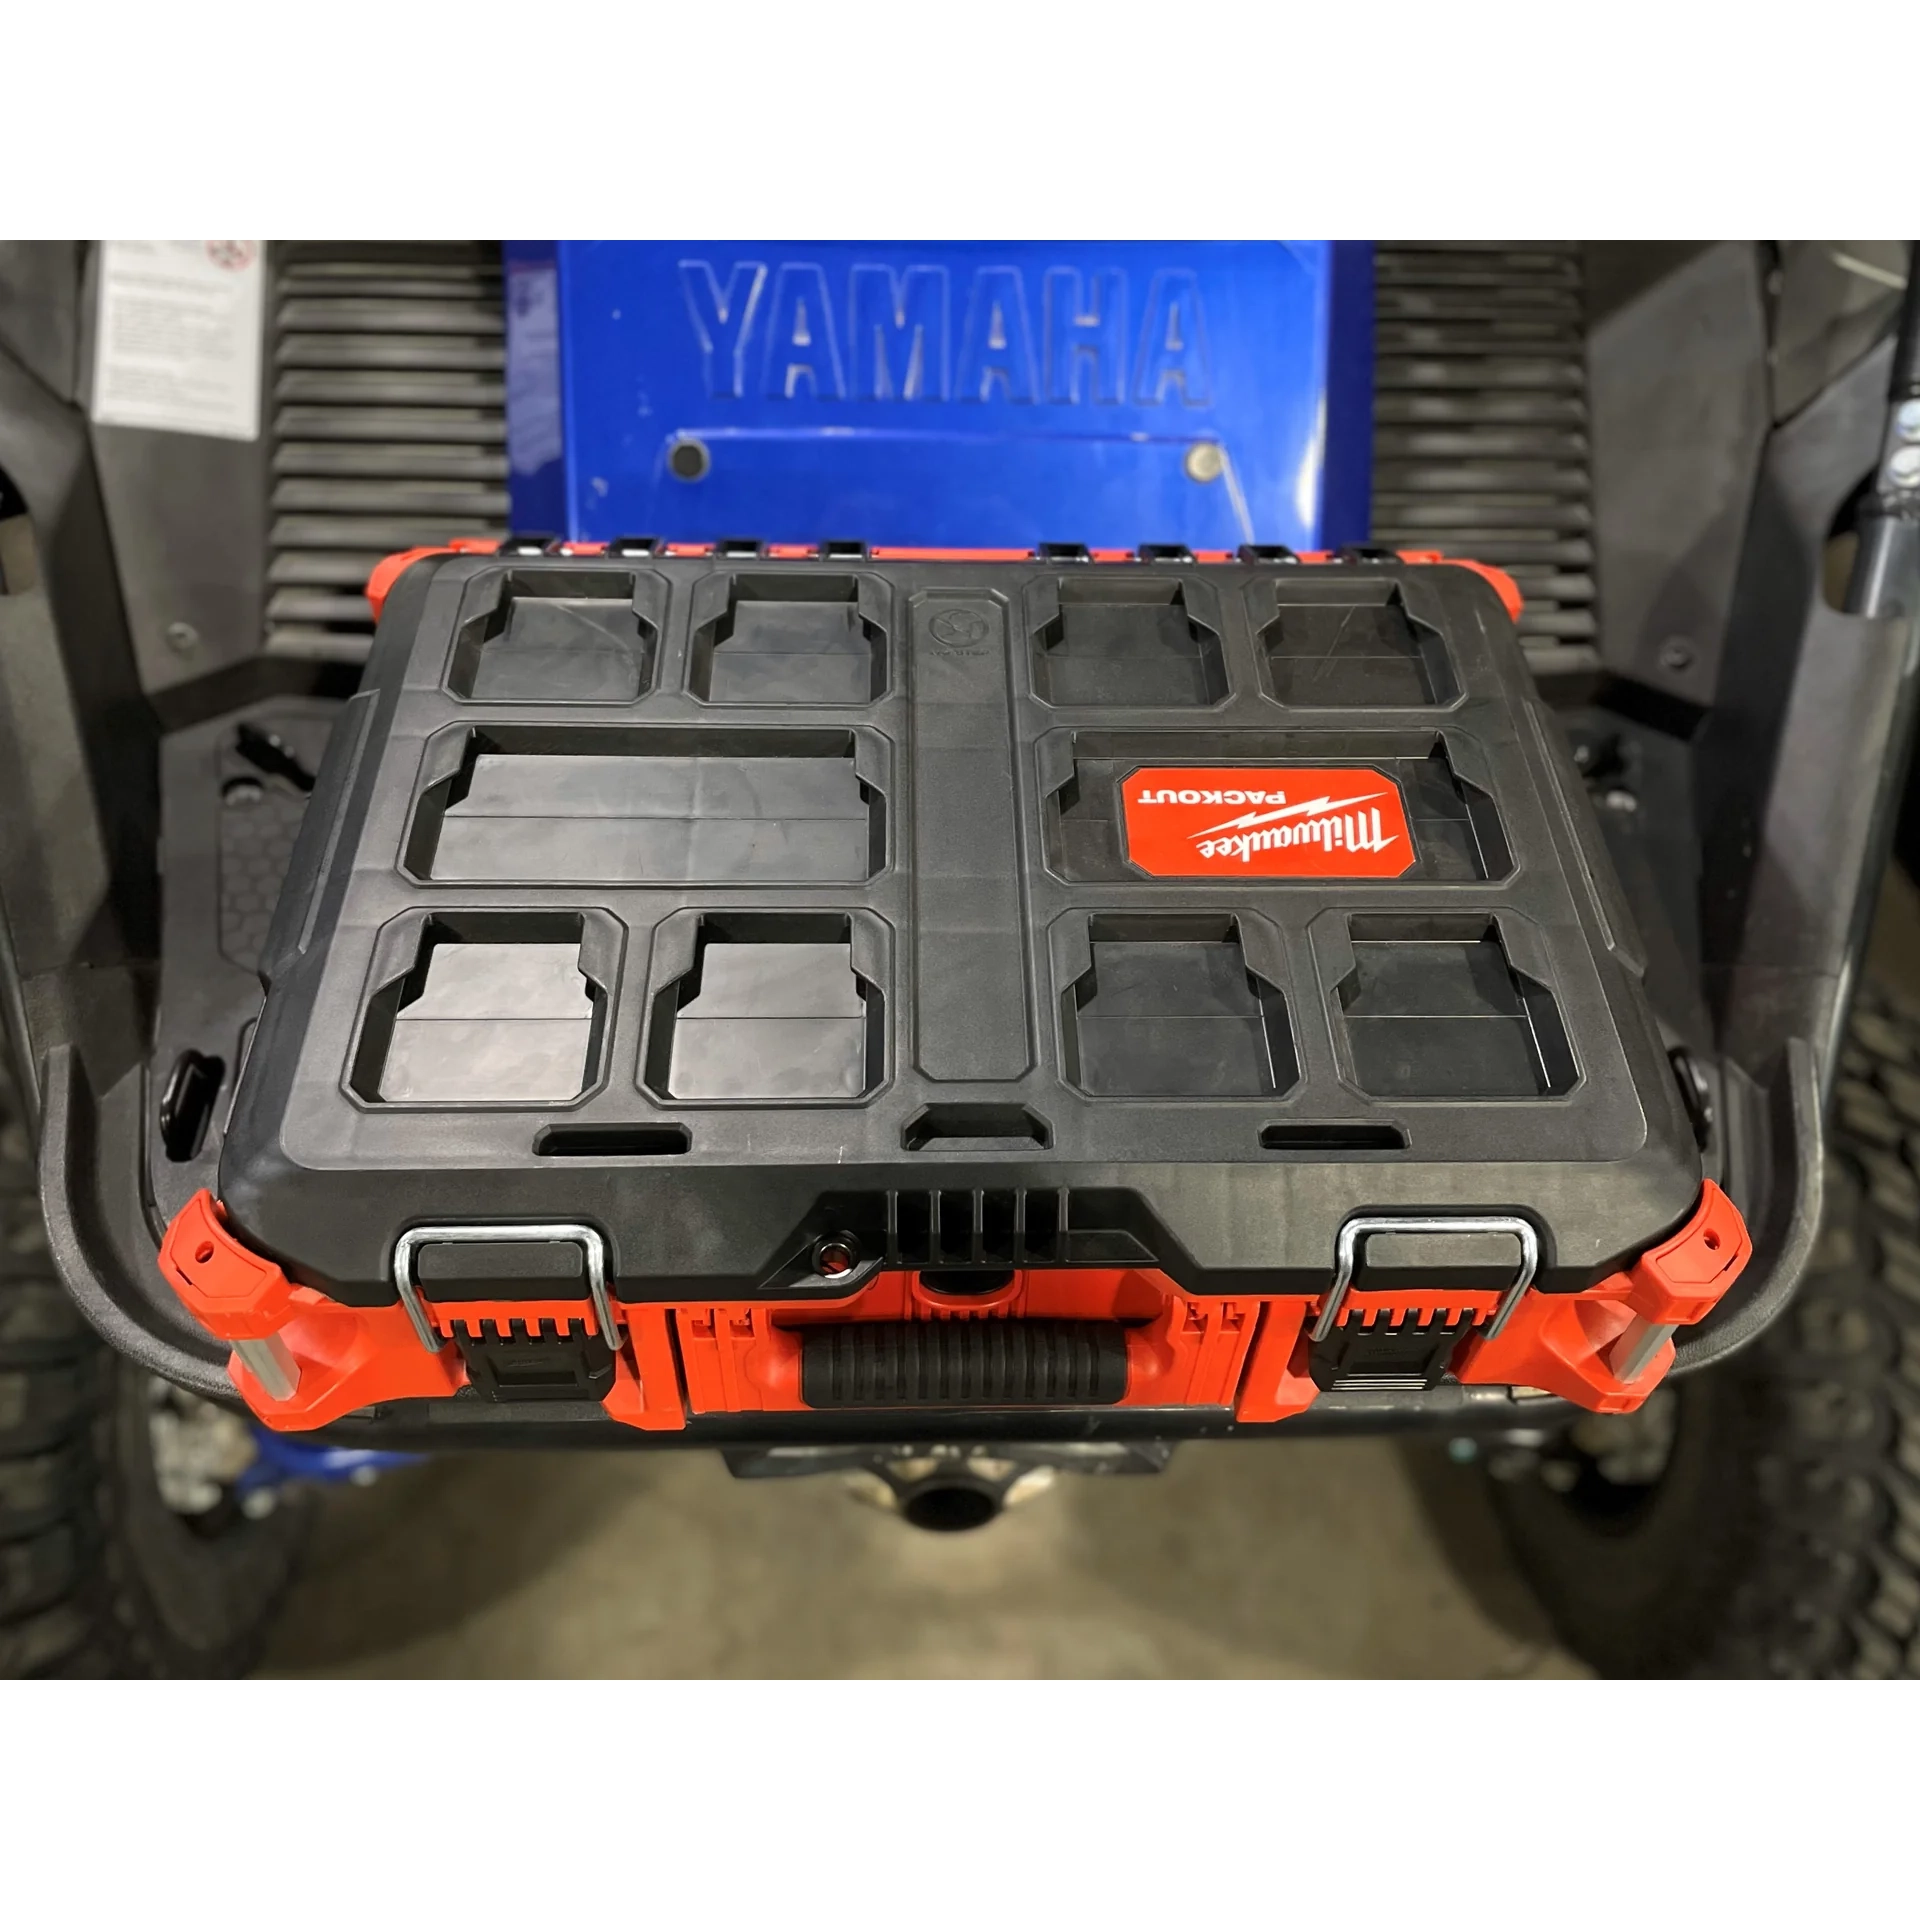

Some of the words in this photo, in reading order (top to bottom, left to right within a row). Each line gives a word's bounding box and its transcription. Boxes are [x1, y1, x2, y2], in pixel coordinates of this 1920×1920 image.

[678, 259, 1212, 408] YAMAHA
[1137, 790, 1286, 805] PACKOUT
[1196, 807, 1399, 862] Milwaukee
